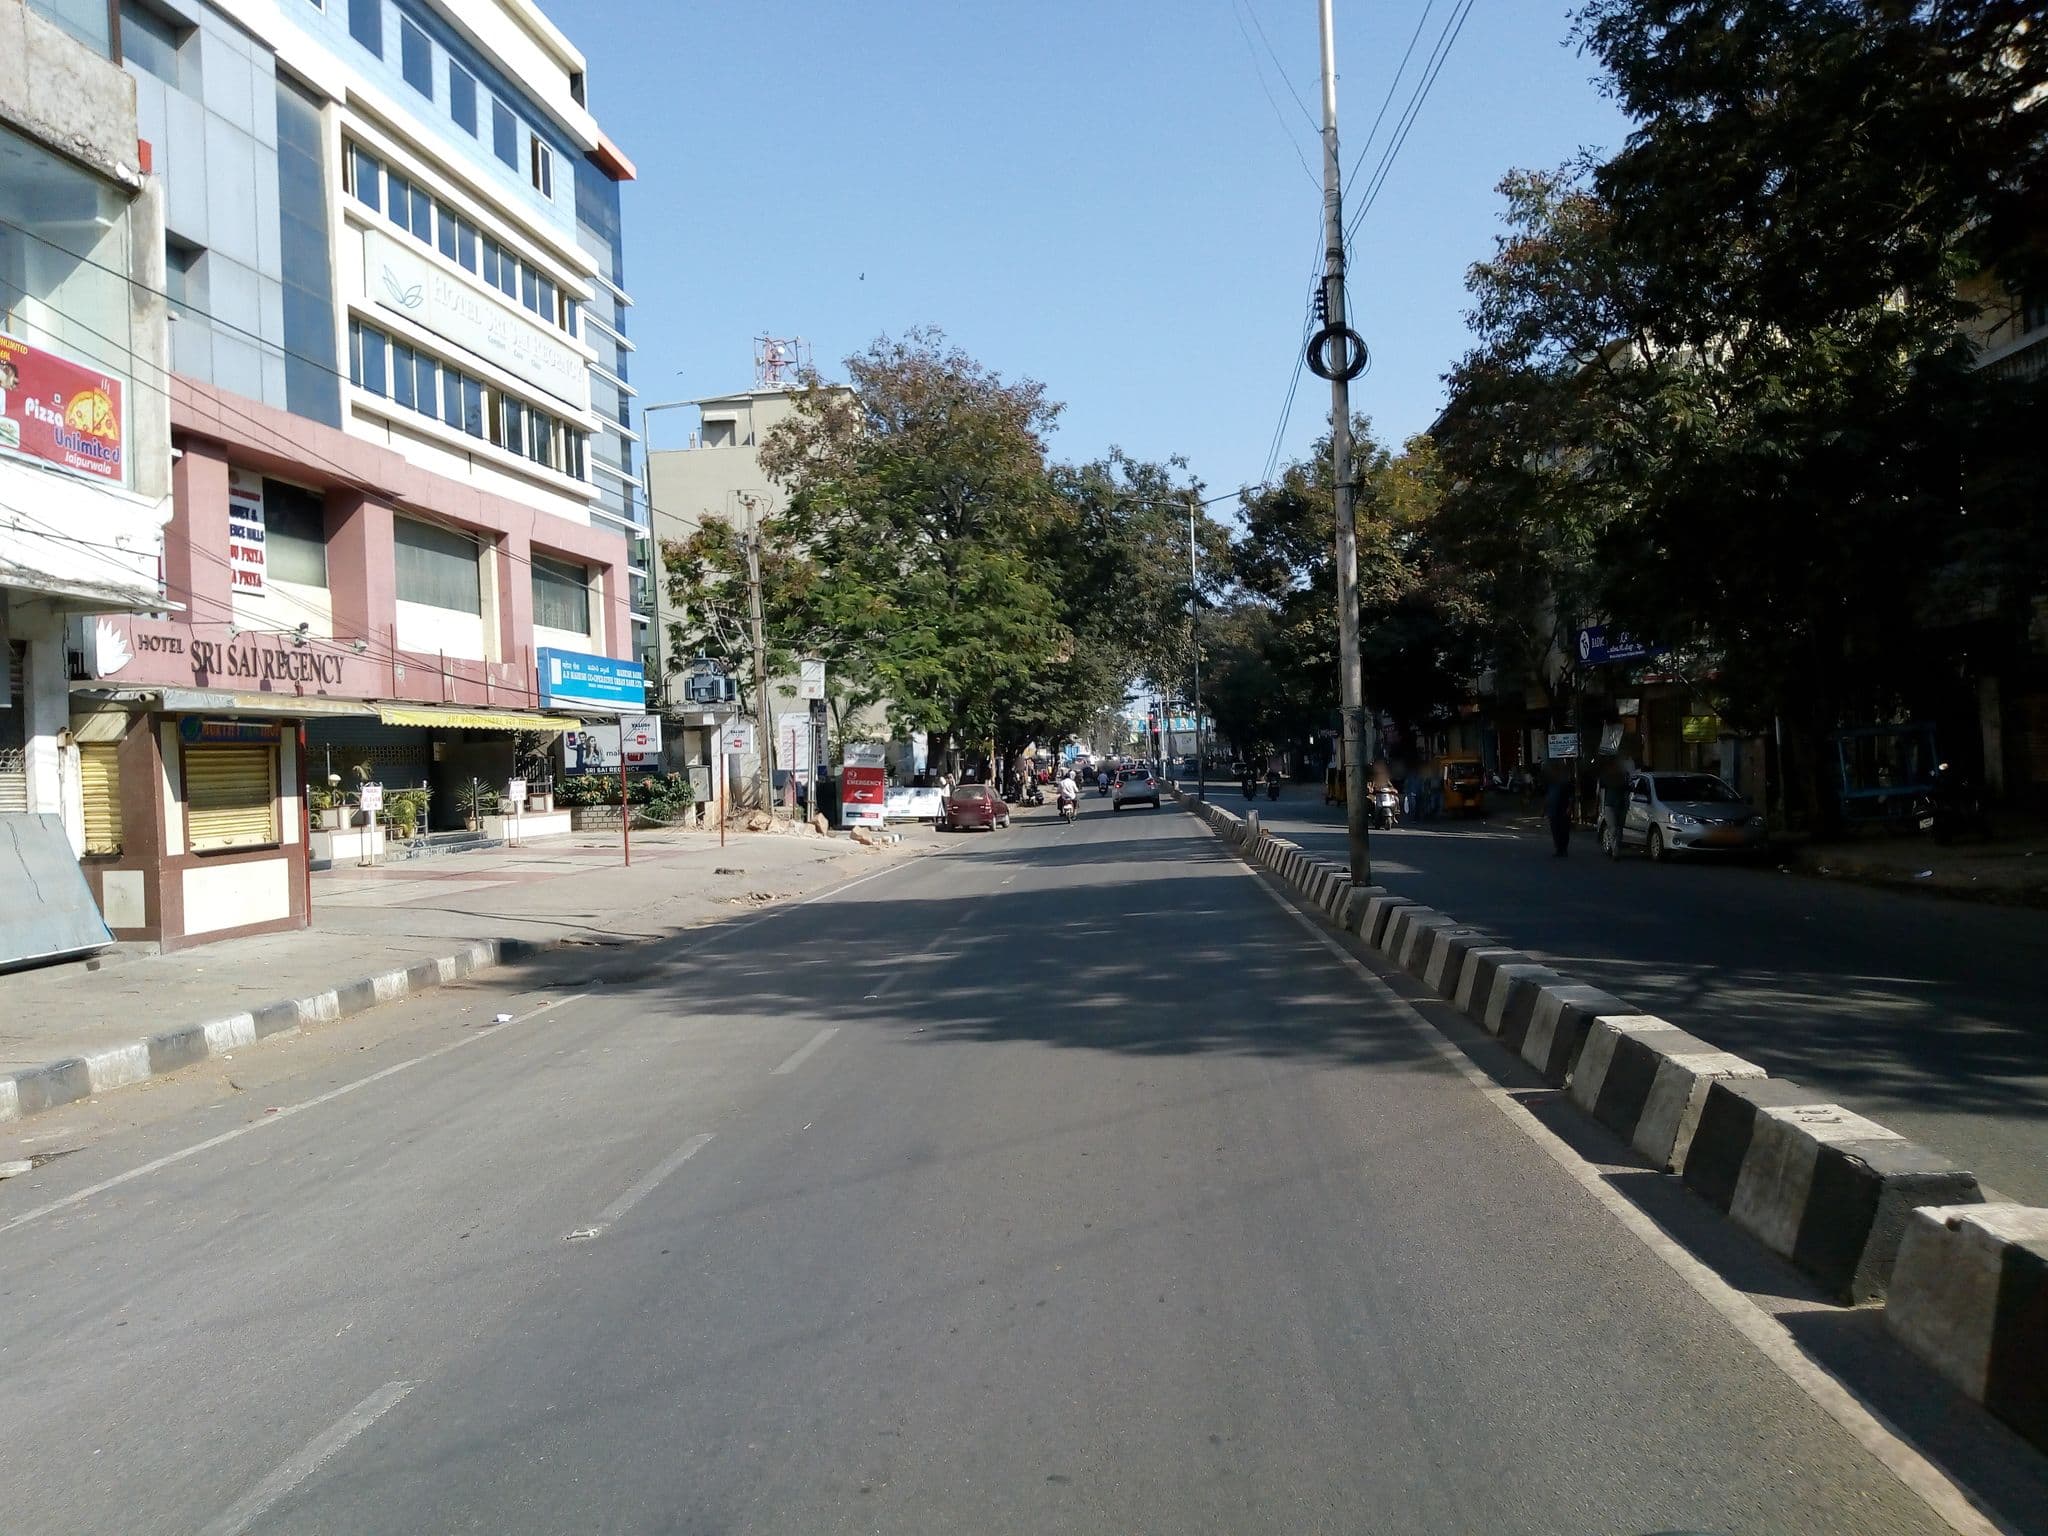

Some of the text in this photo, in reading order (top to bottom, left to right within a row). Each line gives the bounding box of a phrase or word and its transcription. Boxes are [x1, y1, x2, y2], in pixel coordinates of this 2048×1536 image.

[25, 397, 64, 428] Pizza
[54, 427, 120, 464] Unlimited
[65, 452, 112, 475] Jaipurwala
[138, 634, 345, 685] HOTEL SRI SAI REGENCY
[609, 766, 640, 774] REGNCY
